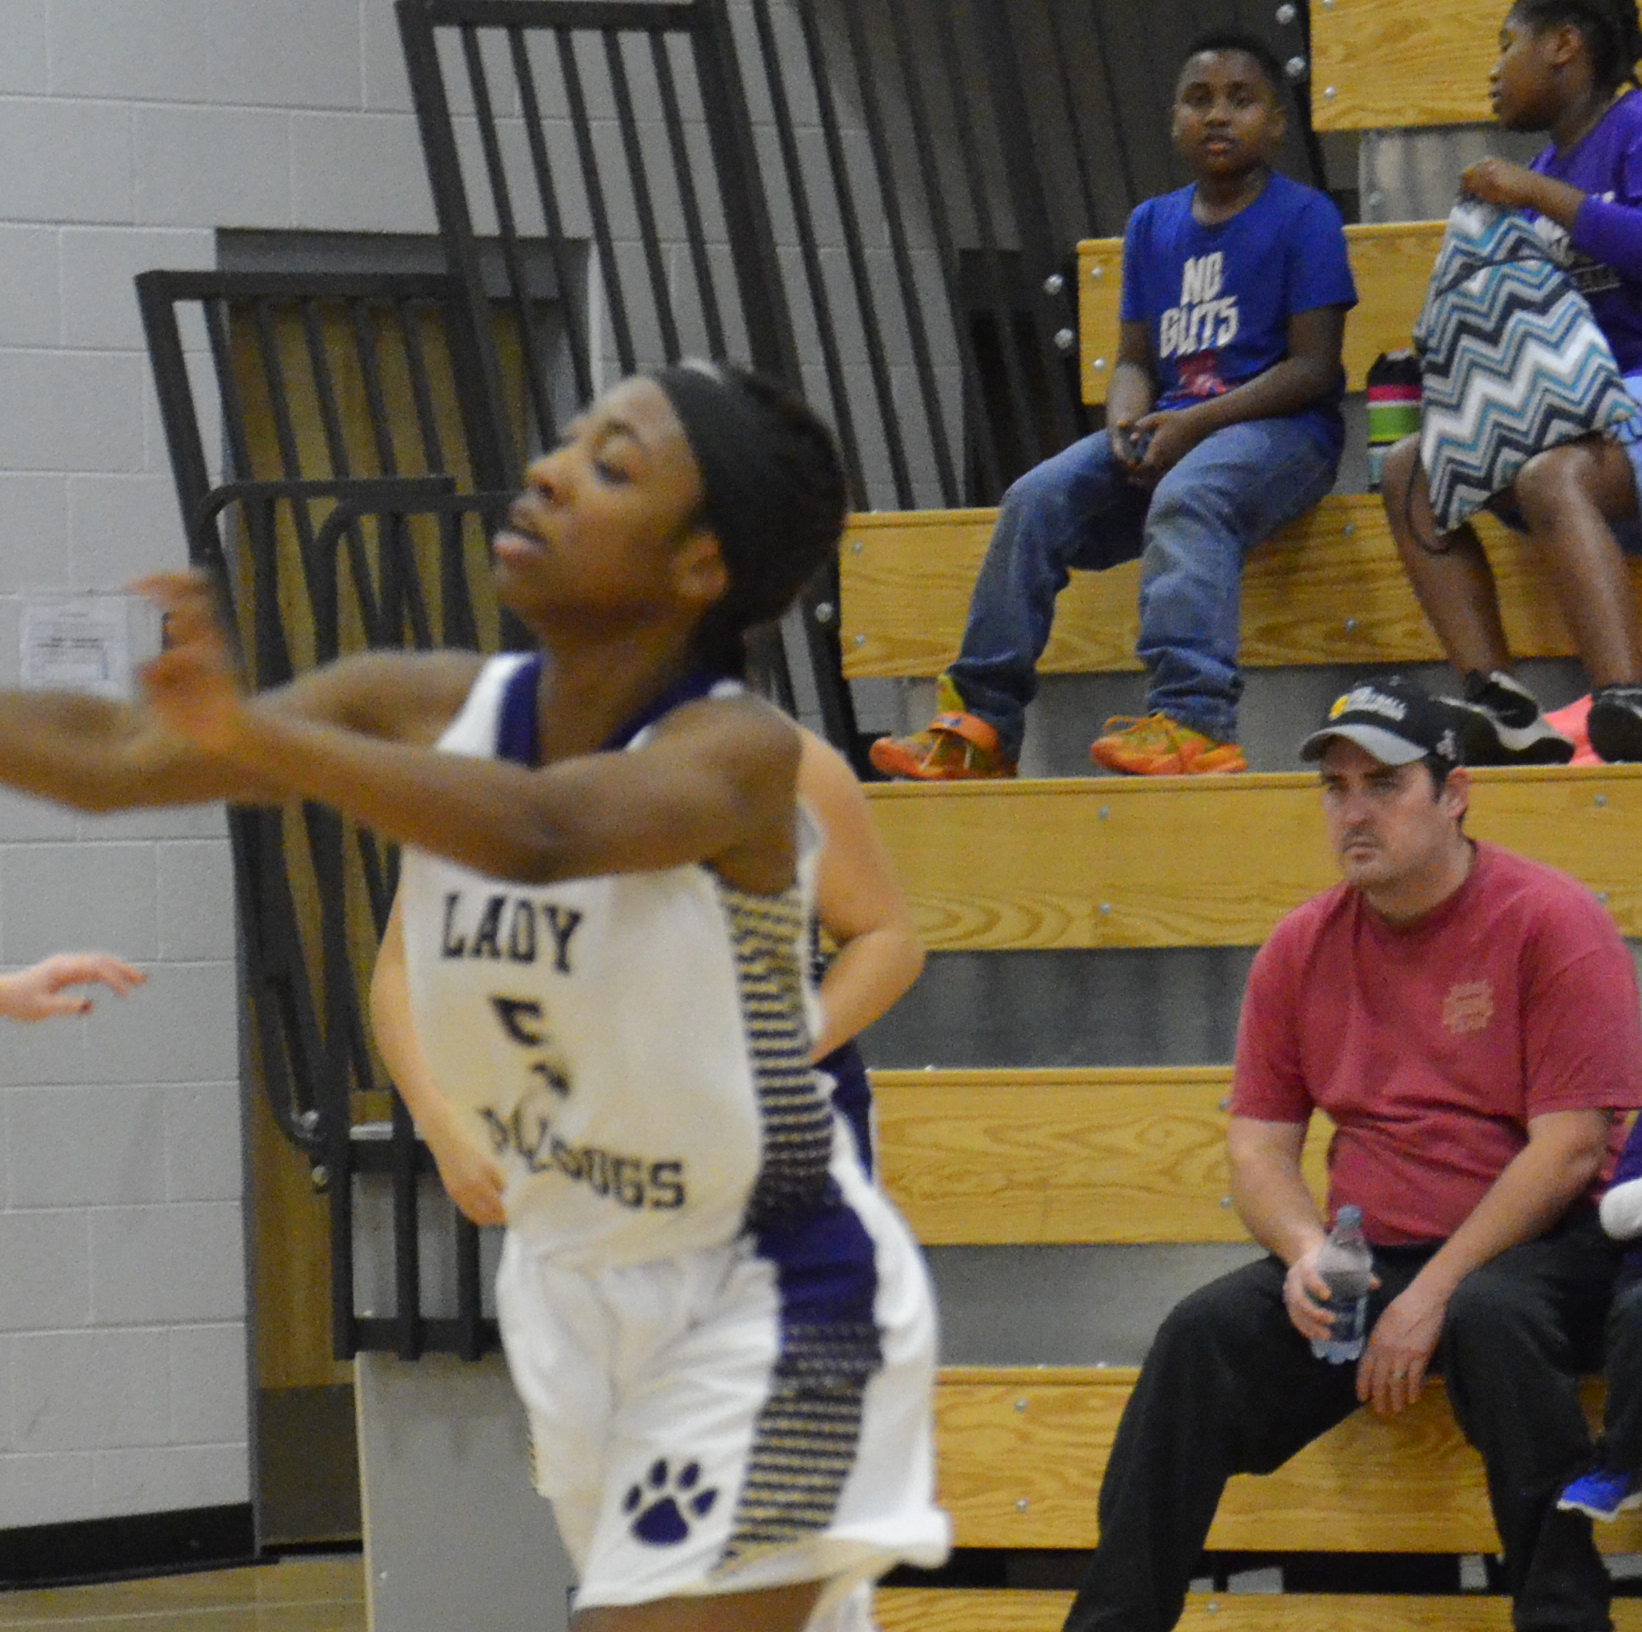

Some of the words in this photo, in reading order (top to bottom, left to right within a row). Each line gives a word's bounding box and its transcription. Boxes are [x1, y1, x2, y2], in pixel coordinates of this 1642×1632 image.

[1180, 251, 1224, 306] NO
[1160, 295, 1239, 358] GUTS
[440, 891, 584, 975] LADY
